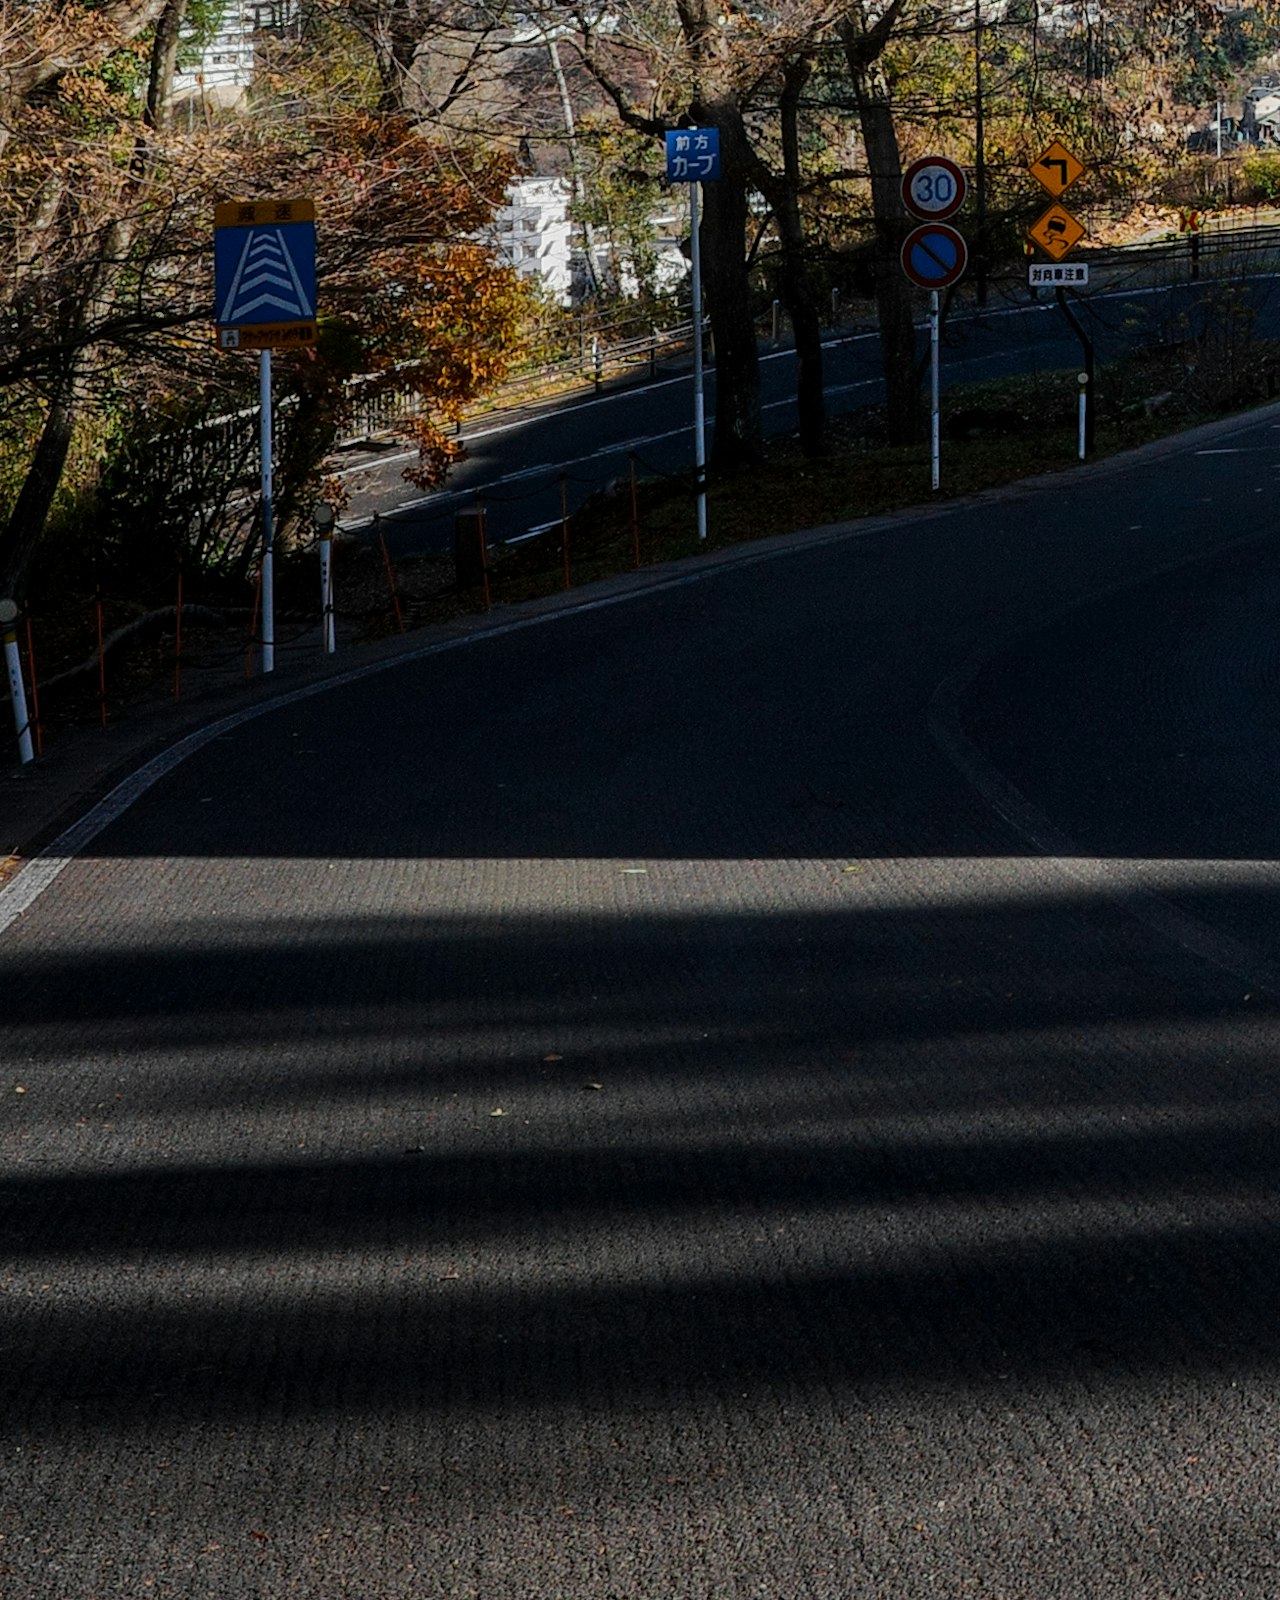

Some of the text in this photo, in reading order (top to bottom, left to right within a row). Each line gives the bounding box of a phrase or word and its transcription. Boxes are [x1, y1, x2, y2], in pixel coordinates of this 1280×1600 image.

[675, 134, 709, 152] 前方
[672, 153, 717, 177] カーブ
[917, 174, 951, 202] 30
[1032, 268, 1085, 282] 対向車注意
